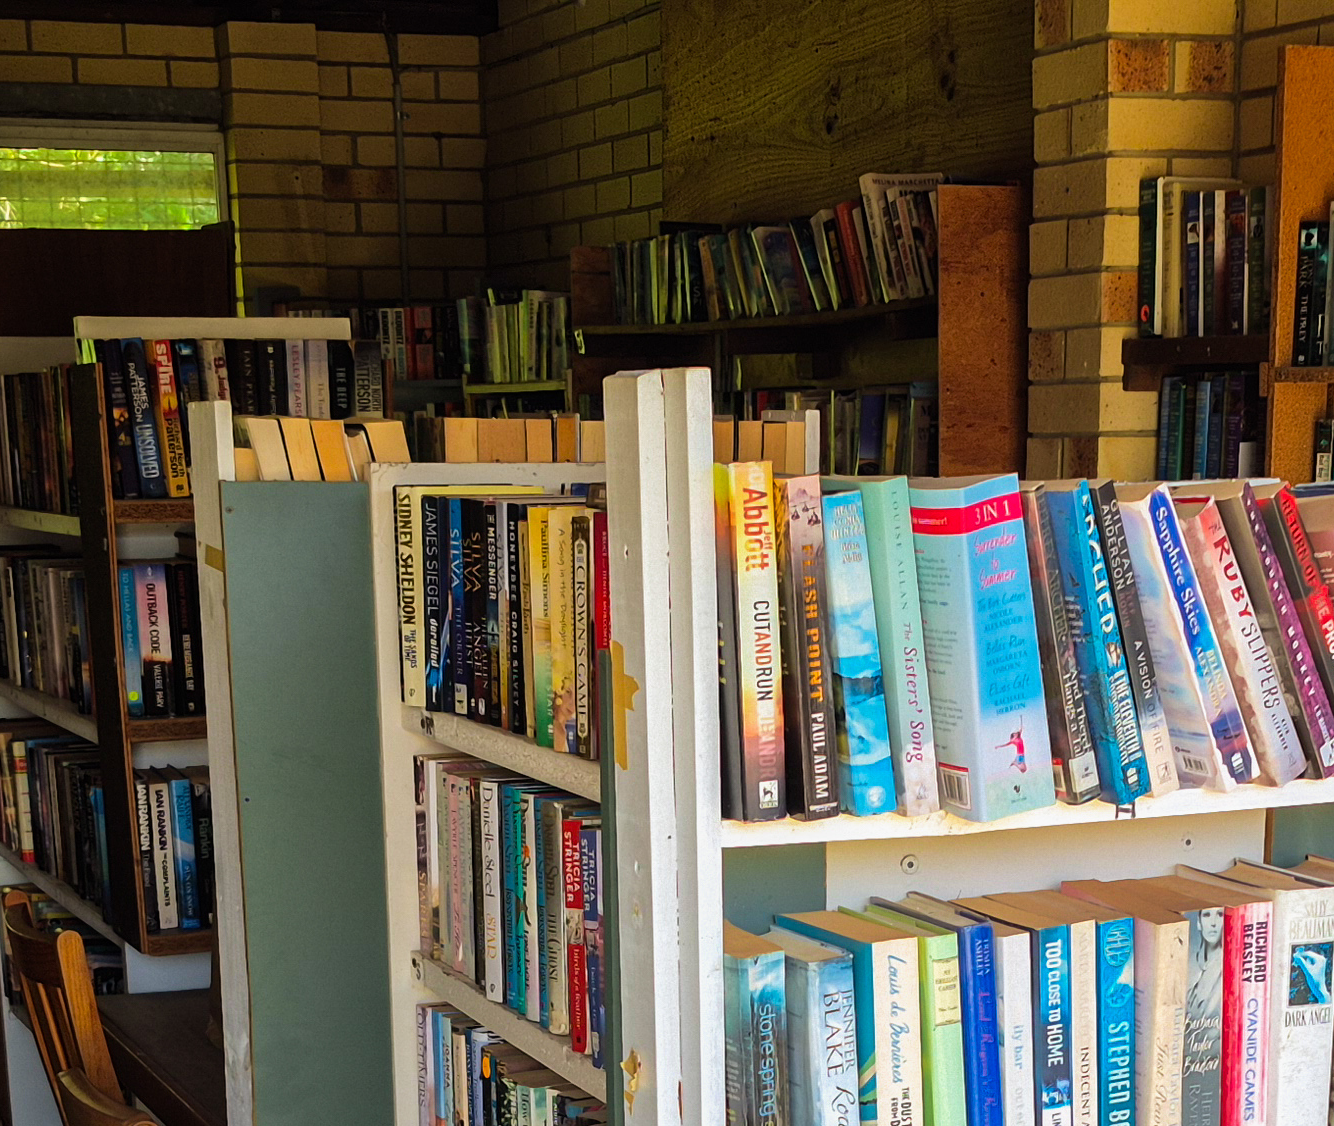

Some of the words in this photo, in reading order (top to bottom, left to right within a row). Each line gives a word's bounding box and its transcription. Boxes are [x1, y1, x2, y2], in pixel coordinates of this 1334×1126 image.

[126, 362, 144, 423] PATTERSON
[141, 424, 161, 479] UNSOLVED
[398, 494, 412, 549] SIDNEY
[425, 503, 438, 556] JAMES
[743, 488, 768, 571] Abbott
[974, 508, 981, 524] 3
[982, 503, 998, 522] IN
[1003, 500, 1011, 516] 1
[487, 527, 497, 600] MESSENGER
[974, 527, 1017, 557] Surrender
[1101, 505, 1125, 591] ANDERSON
[1110, 500, 1134, 585] GILLIAN
[400, 552, 416, 625] SHELDON
[427, 561, 439, 615] SIEGEL
[801, 544, 818, 619] FLASH
[979, 568, 1016, 590] Summer
[1154, 506, 1185, 587] Sapphire
[1180, 589, 1201, 636] Skies
[146, 583, 158, 628] OUTBACK
[149, 632, 161, 654] CODE
[806, 624, 823, 702] POINT
[1133, 641, 1142, 651] A
[1136, 655, 1153, 700] VISION
[811, 712, 826, 744] PAUL
[1146, 703, 1158, 722] OF
[1152, 726, 1164, 755] FIRE
[813, 747, 828, 798] ADAM
[157, 808, 167, 851] RANKIN
[483, 787, 494, 860] Danielle
[564, 832, 573, 903] STRINGER
[573, 843, 581, 892] TRICIA
[581, 838, 591, 912] STRINGER
[1045, 938, 1063, 970] TOO
[1242, 923, 1254, 983] BEASLEY
[1254, 921, 1268, 984] RICHARD
[1047, 971, 1061, 1007] CLOSE
[1048, 1008, 1061, 1021] TO
[822, 992, 845, 1078] BLAKE
[839, 989, 856, 1071] JENNIFER
[1047, 1024, 1063, 1067] HOME
[1246, 997, 1260, 1065] CYANIDE
[1079, 1047, 1091, 1117] INDECENT
[1107, 1021, 1130, 1105] STEPHEN
[902, 1087, 910, 1101] THE
[1243, 1067, 1255, 1122] GAMES
